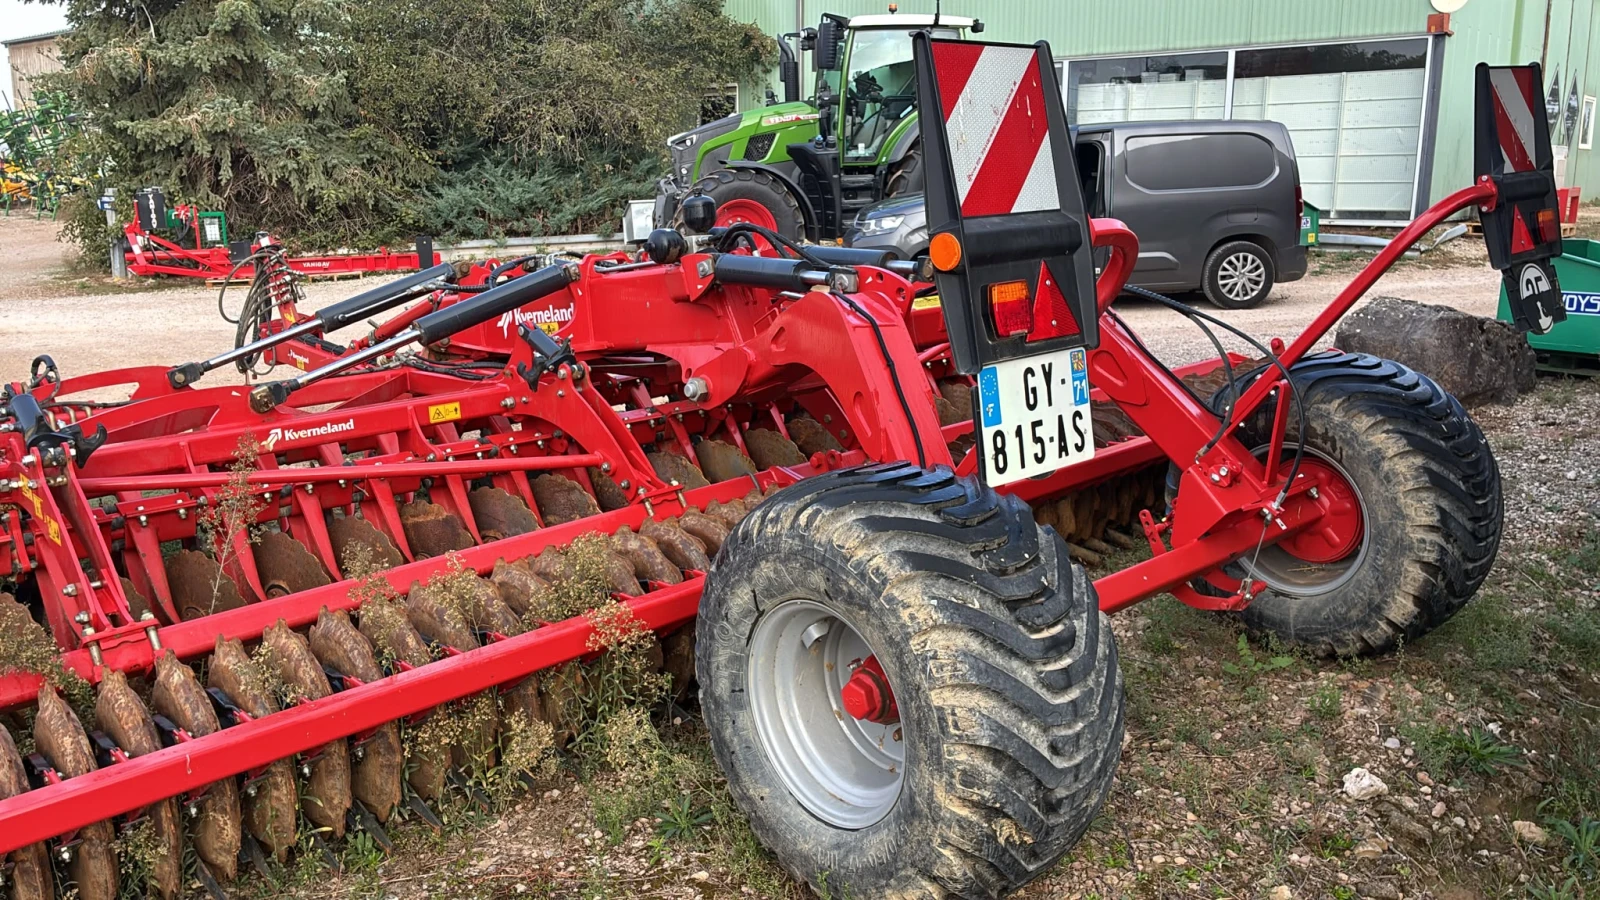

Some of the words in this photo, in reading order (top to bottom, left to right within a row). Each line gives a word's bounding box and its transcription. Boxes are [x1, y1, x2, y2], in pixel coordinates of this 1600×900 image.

[513, 302, 574, 326] Kverneland
[1073, 378, 1088, 401] 71
[986, 403, 995, 418] F
[284, 418, 355, 441] Kverneland
[992, 410, 1086, 475] 815-AS
